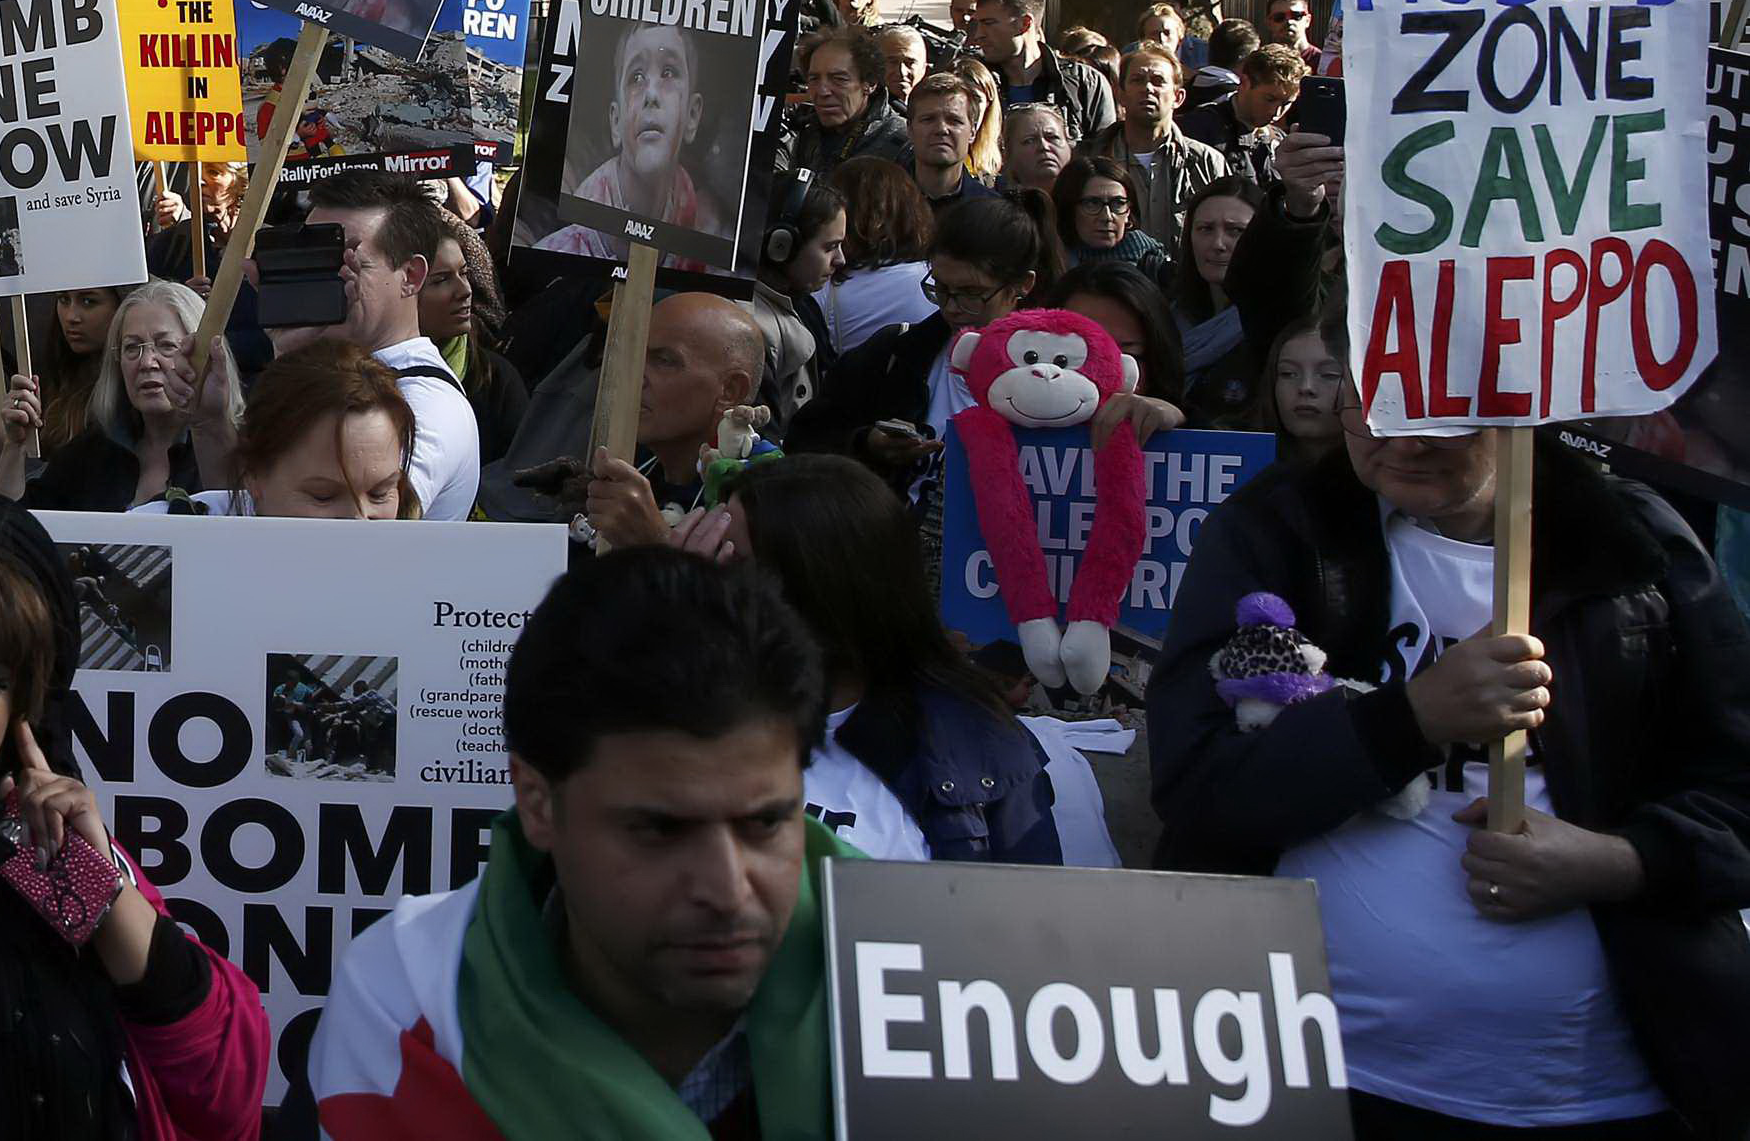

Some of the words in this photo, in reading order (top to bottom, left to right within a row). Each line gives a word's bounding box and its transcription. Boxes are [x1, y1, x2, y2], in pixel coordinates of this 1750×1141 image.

[176, 0, 213, 24] THE
[294, 1, 334, 24] AVAAZ
[139, 33, 239, 68] KILLIN
[1391, 4, 1654, 115] ZONE
[187, 76, 208, 99] IN
[385, 154, 450, 173] Mirror
[1374, 109, 1666, 255] SAVE
[26, 193, 51, 211] and
[54, 195, 82, 208] save
[86, 186, 122, 208] Syria
[624, 219, 656, 240] AVAAZ
[1361, 236, 1699, 423] ALEPPO
[1558, 430, 1614, 458] AVAAZ
[1142, 451, 1242, 503] THE
[461, 640, 515, 654] (childre
[410, 705, 463, 719] (rescue
[70, 690, 253, 788] NO
[420, 759, 514, 784] civilian
[854, 941, 1349, 1126] Enough
